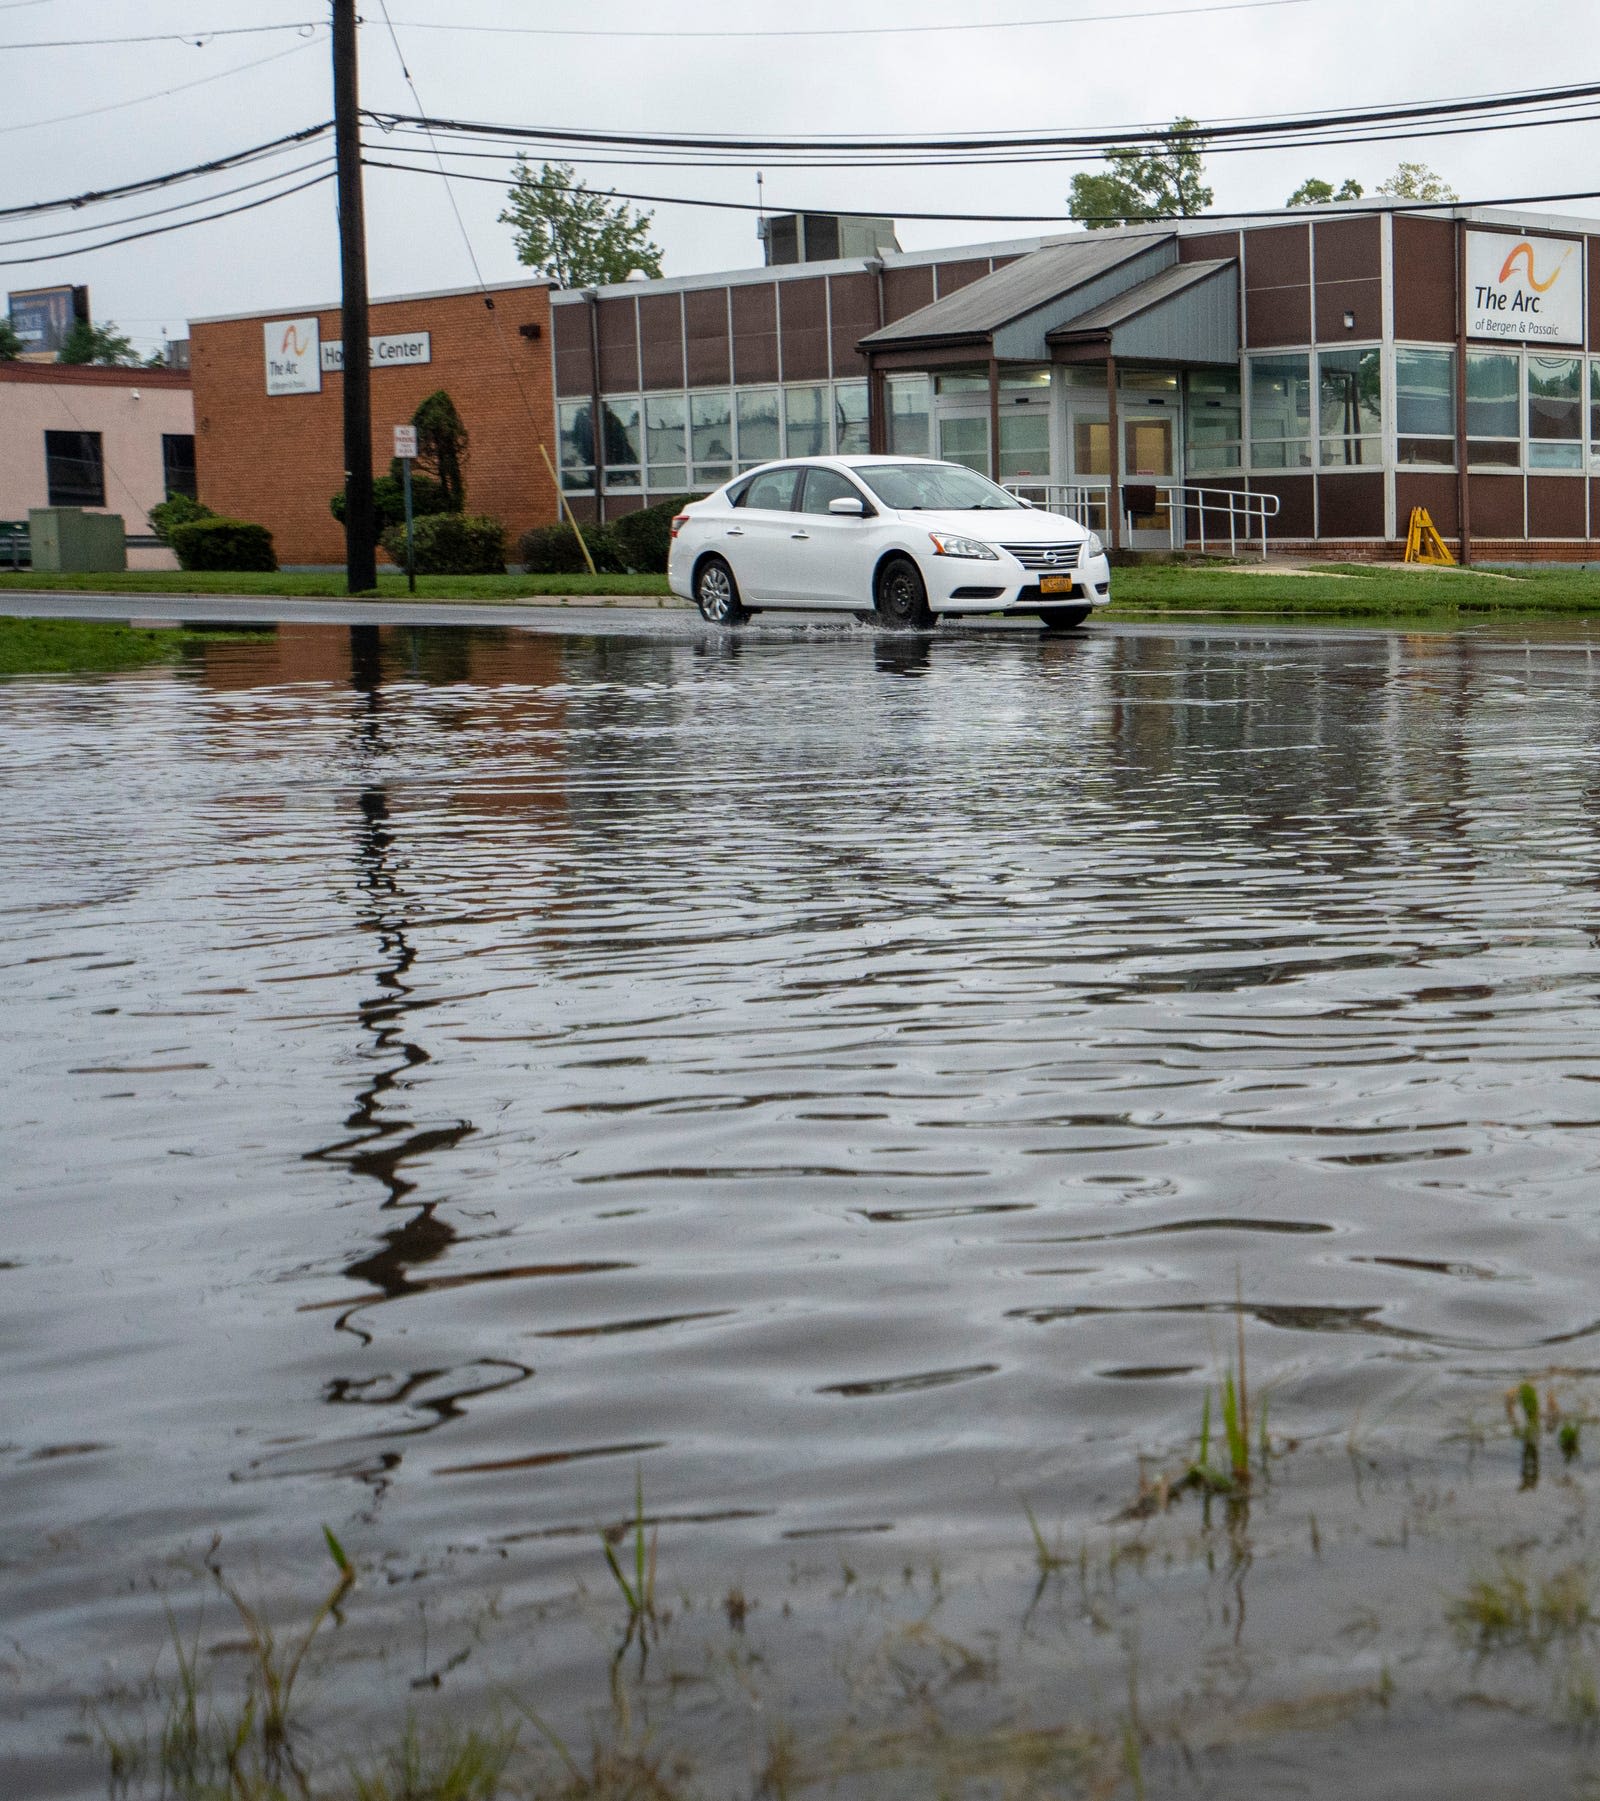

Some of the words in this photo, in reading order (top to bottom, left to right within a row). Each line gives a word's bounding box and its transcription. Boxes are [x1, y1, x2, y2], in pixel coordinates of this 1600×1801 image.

[1475, 286, 1507, 311] The
[1511, 290, 1540, 313] Arc
[1475, 319, 1485, 330] of
[1486, 319, 1517, 335] Bergen
[1519, 321, 1526, 333] &
[1528, 321, 1560, 336] Passaic
[378, 342, 424, 360] Center
[270, 361, 284, 377] The
[286, 360, 298, 375] Arc
